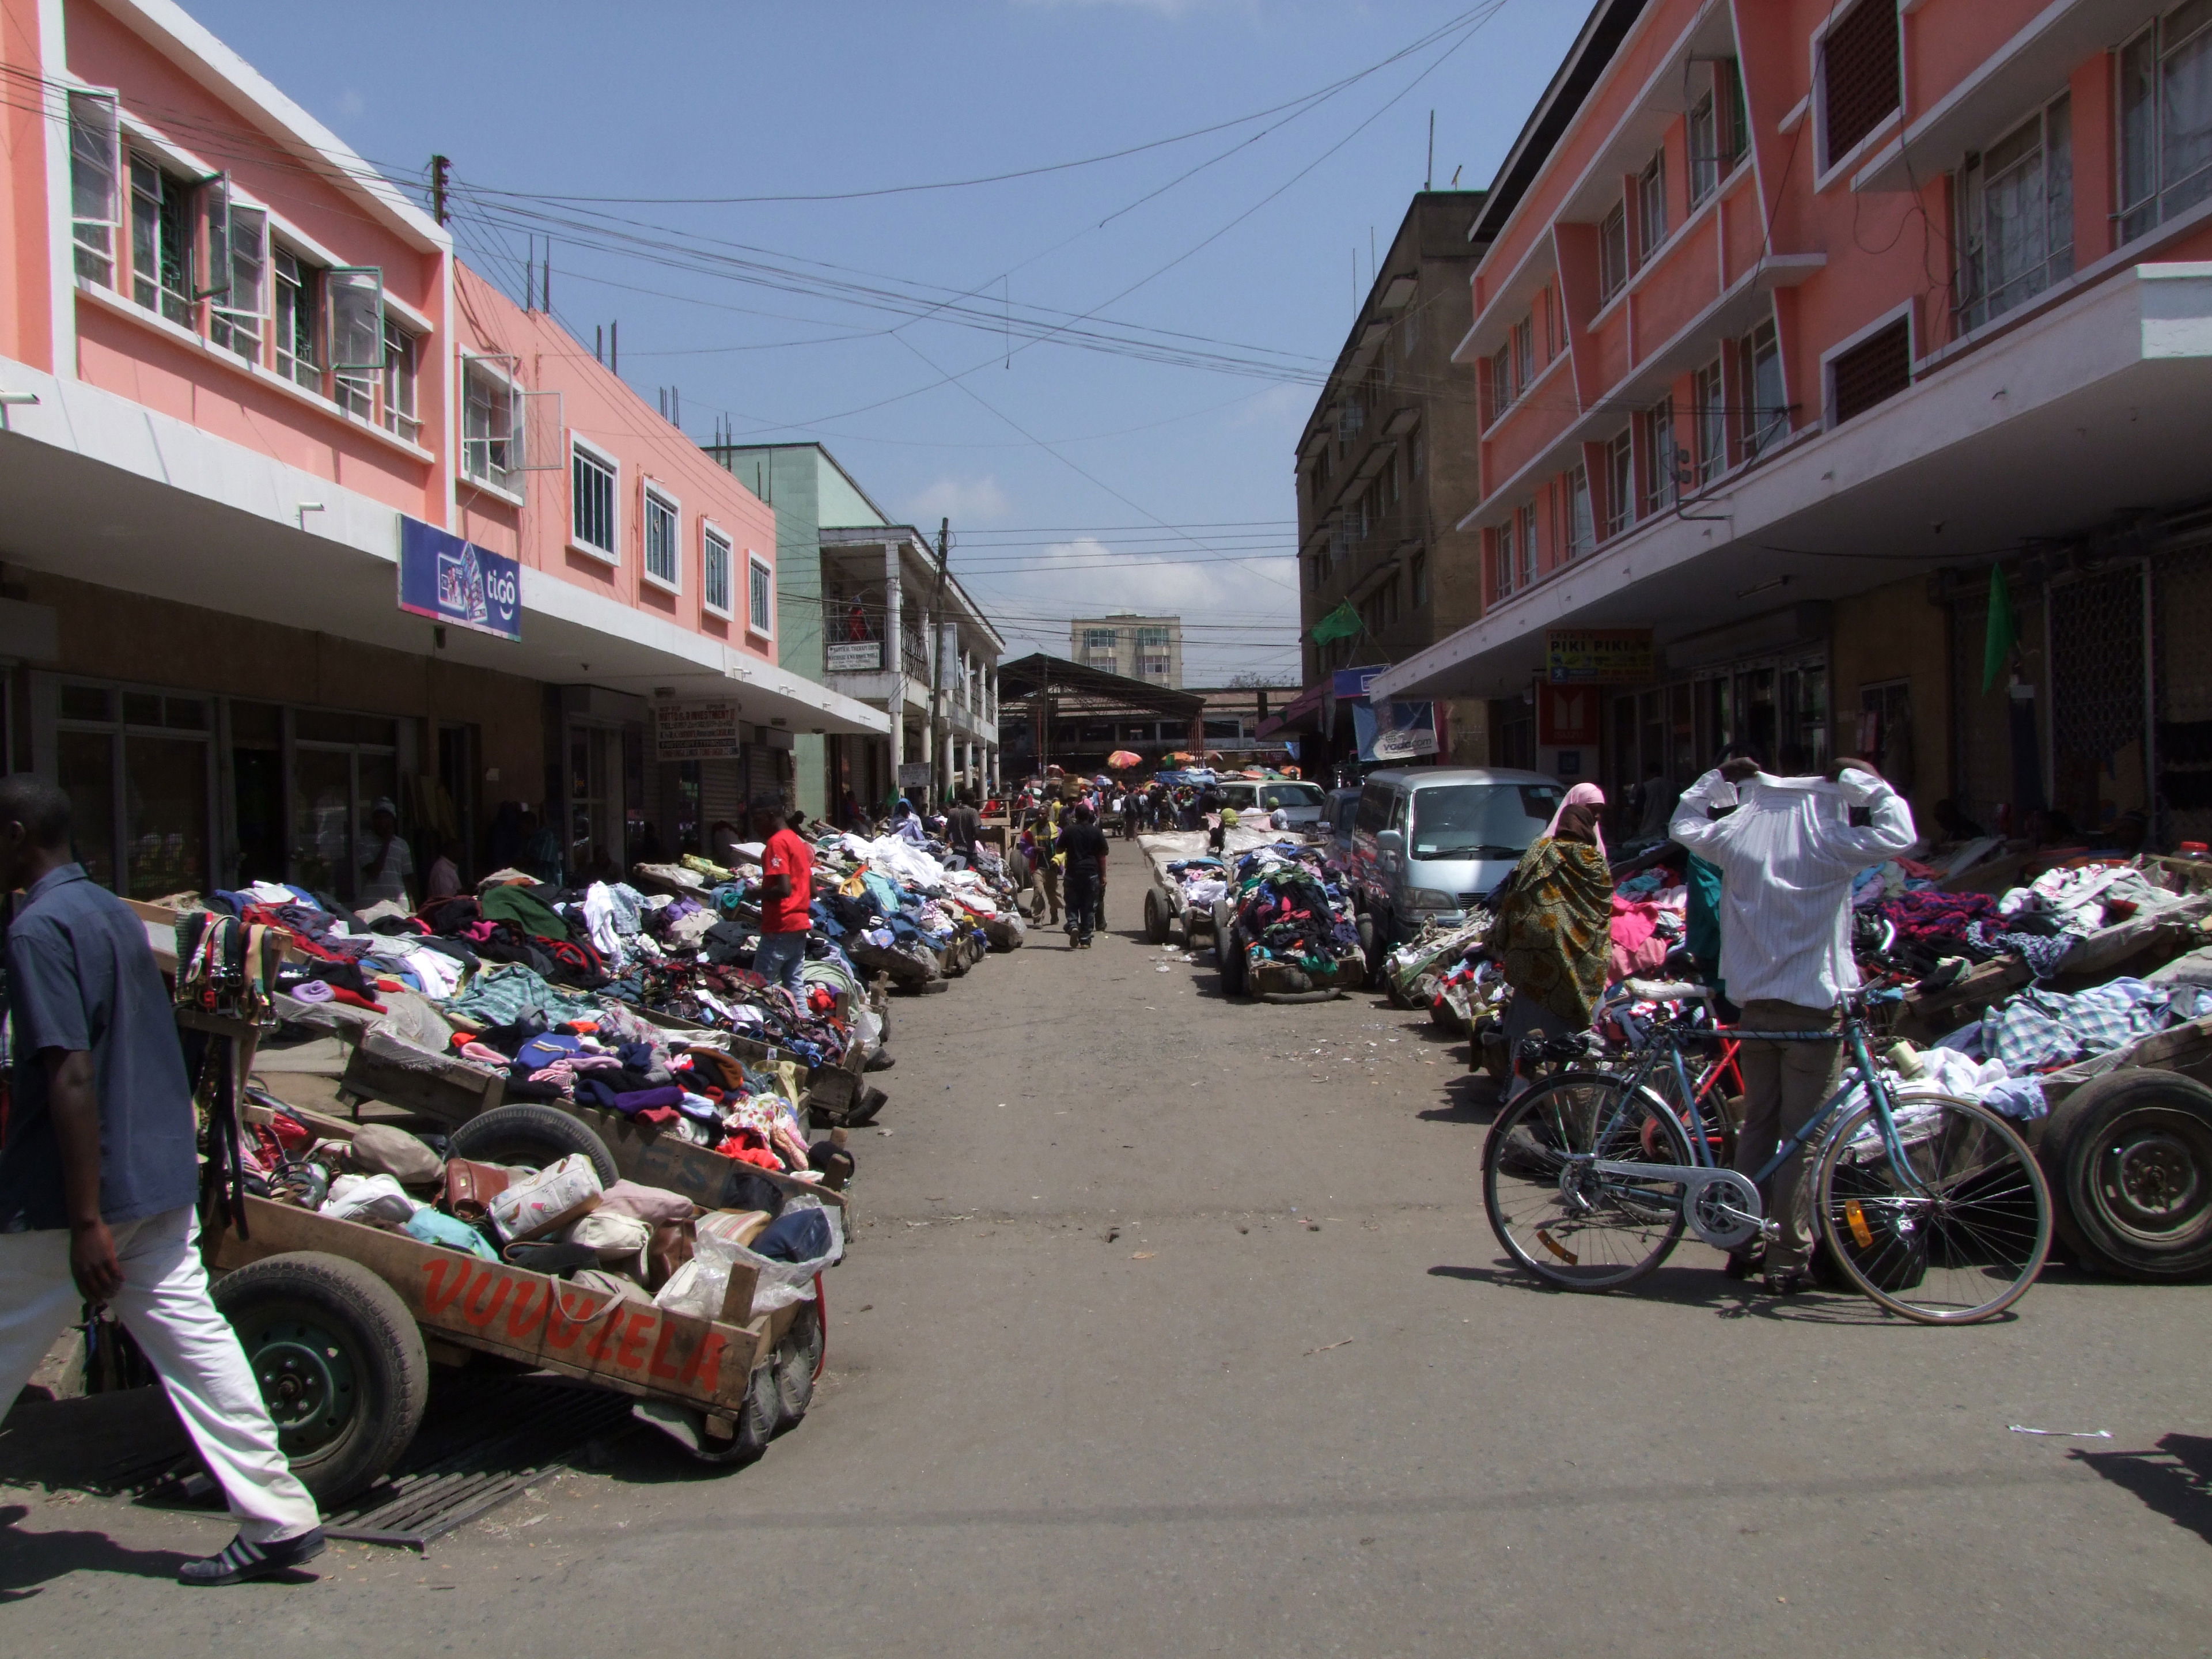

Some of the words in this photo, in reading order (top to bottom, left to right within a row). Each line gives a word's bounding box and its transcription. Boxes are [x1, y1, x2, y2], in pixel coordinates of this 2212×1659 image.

[1551, 641, 1586, 652] PIKI
[1594, 641, 1629, 652] PIKI
[691, 710, 729, 720] INVESTMENT
[1554, 730, 1584, 739] ISUZU
[422, 1259, 726, 1392] VUVUZELA
